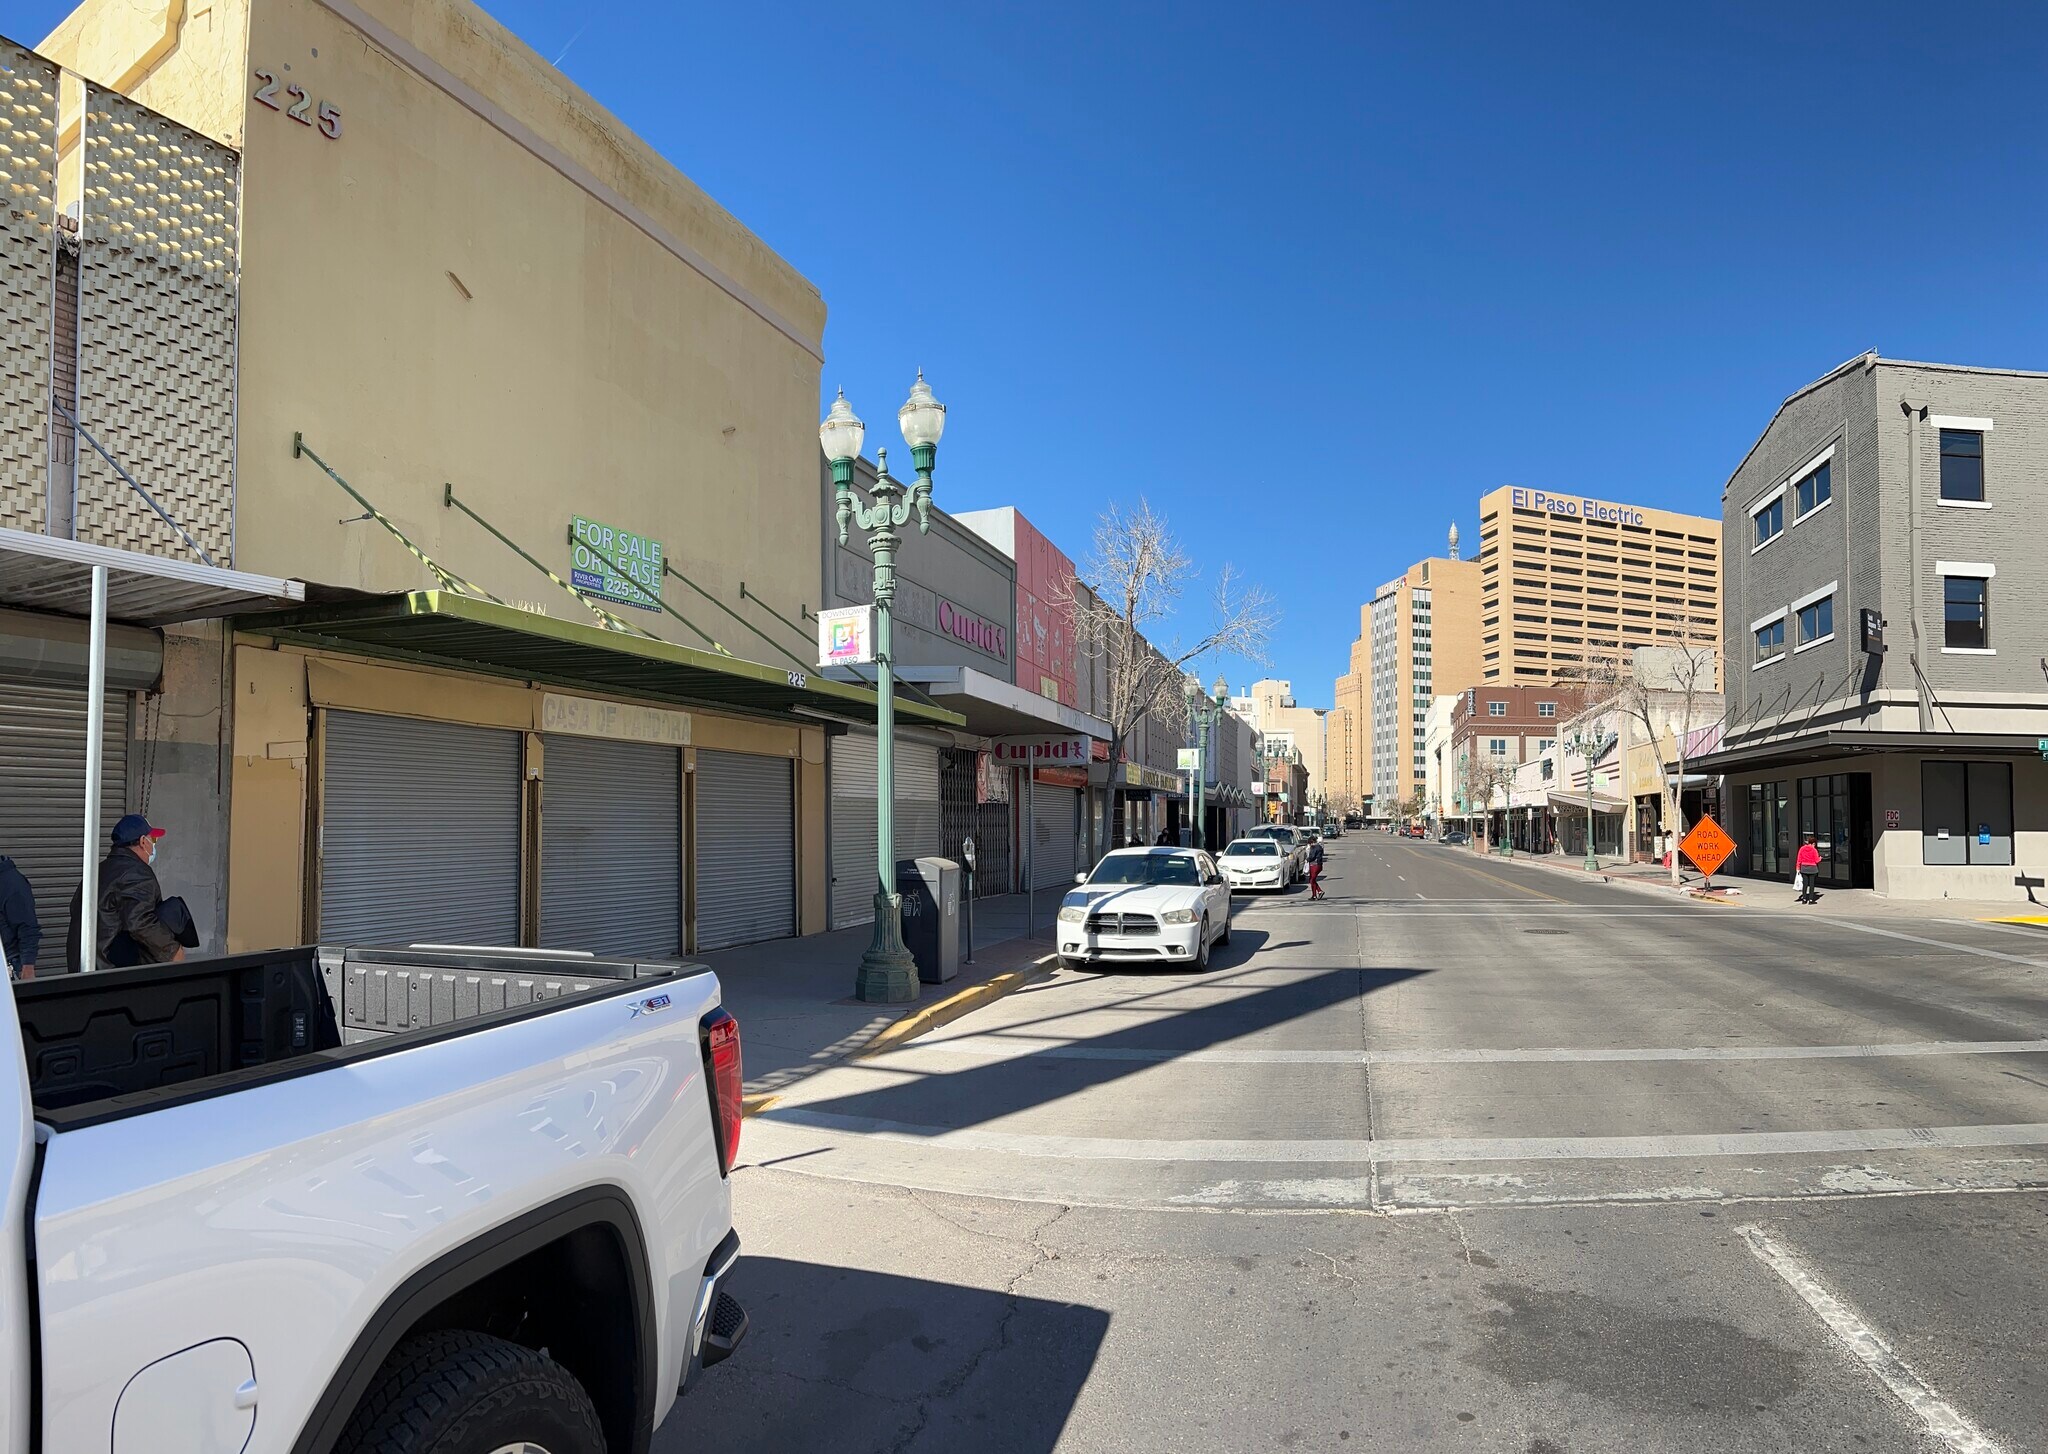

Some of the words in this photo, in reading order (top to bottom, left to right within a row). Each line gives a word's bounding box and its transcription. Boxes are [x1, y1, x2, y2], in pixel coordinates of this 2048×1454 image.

[253, 67, 342, 140] 225
[1512, 488, 1528, 508] El
[1534, 492, 1577, 515] Paso
[1582, 499, 1643, 526] Electric
[576, 519, 613, 551] FOR
[619, 532, 660, 565] SALE
[575, 545, 603, 573] OR
[607, 553, 660, 588] LEASE
[822, 606, 867, 619] DOWNTOWN
[831, 657, 838, 666] EL
[840, 655, 858, 666] PASO
[788, 671, 806, 688] 225
[544, 698, 590, 730] CASA
[596, 703, 616, 733] DE
[995, 741, 1068, 760] Cupid
[1886, 810, 1899, 821] FDC
[1697, 830, 1719, 839] ROAD
[1697, 842, 1720, 851] WORK
[1696, 853, 1721, 862] AHEAD
[624, 995, 671, 1019] X31
